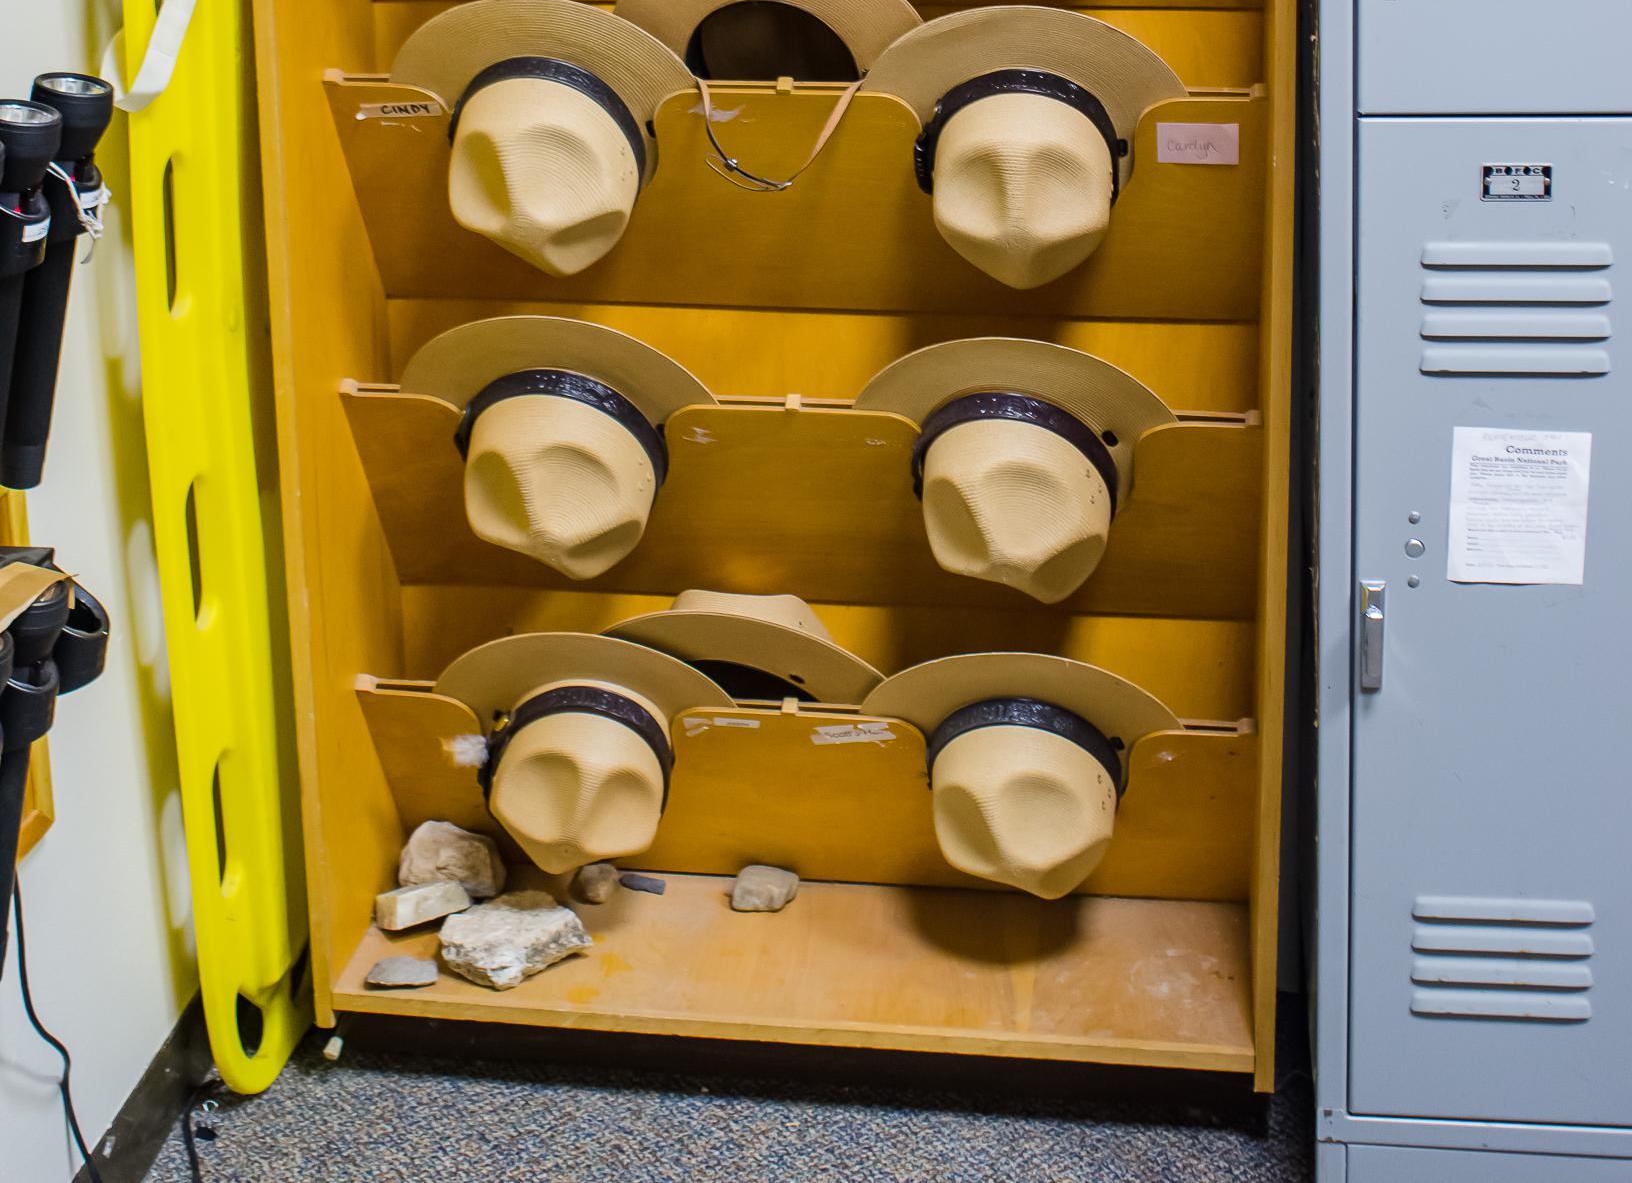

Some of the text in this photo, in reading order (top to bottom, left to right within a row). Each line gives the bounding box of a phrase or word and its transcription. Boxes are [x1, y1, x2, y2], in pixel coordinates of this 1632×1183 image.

[380, 104, 431, 115] CINDY
[1511, 178, 1521, 192] 2
[1505, 445, 1569, 456] Comments
